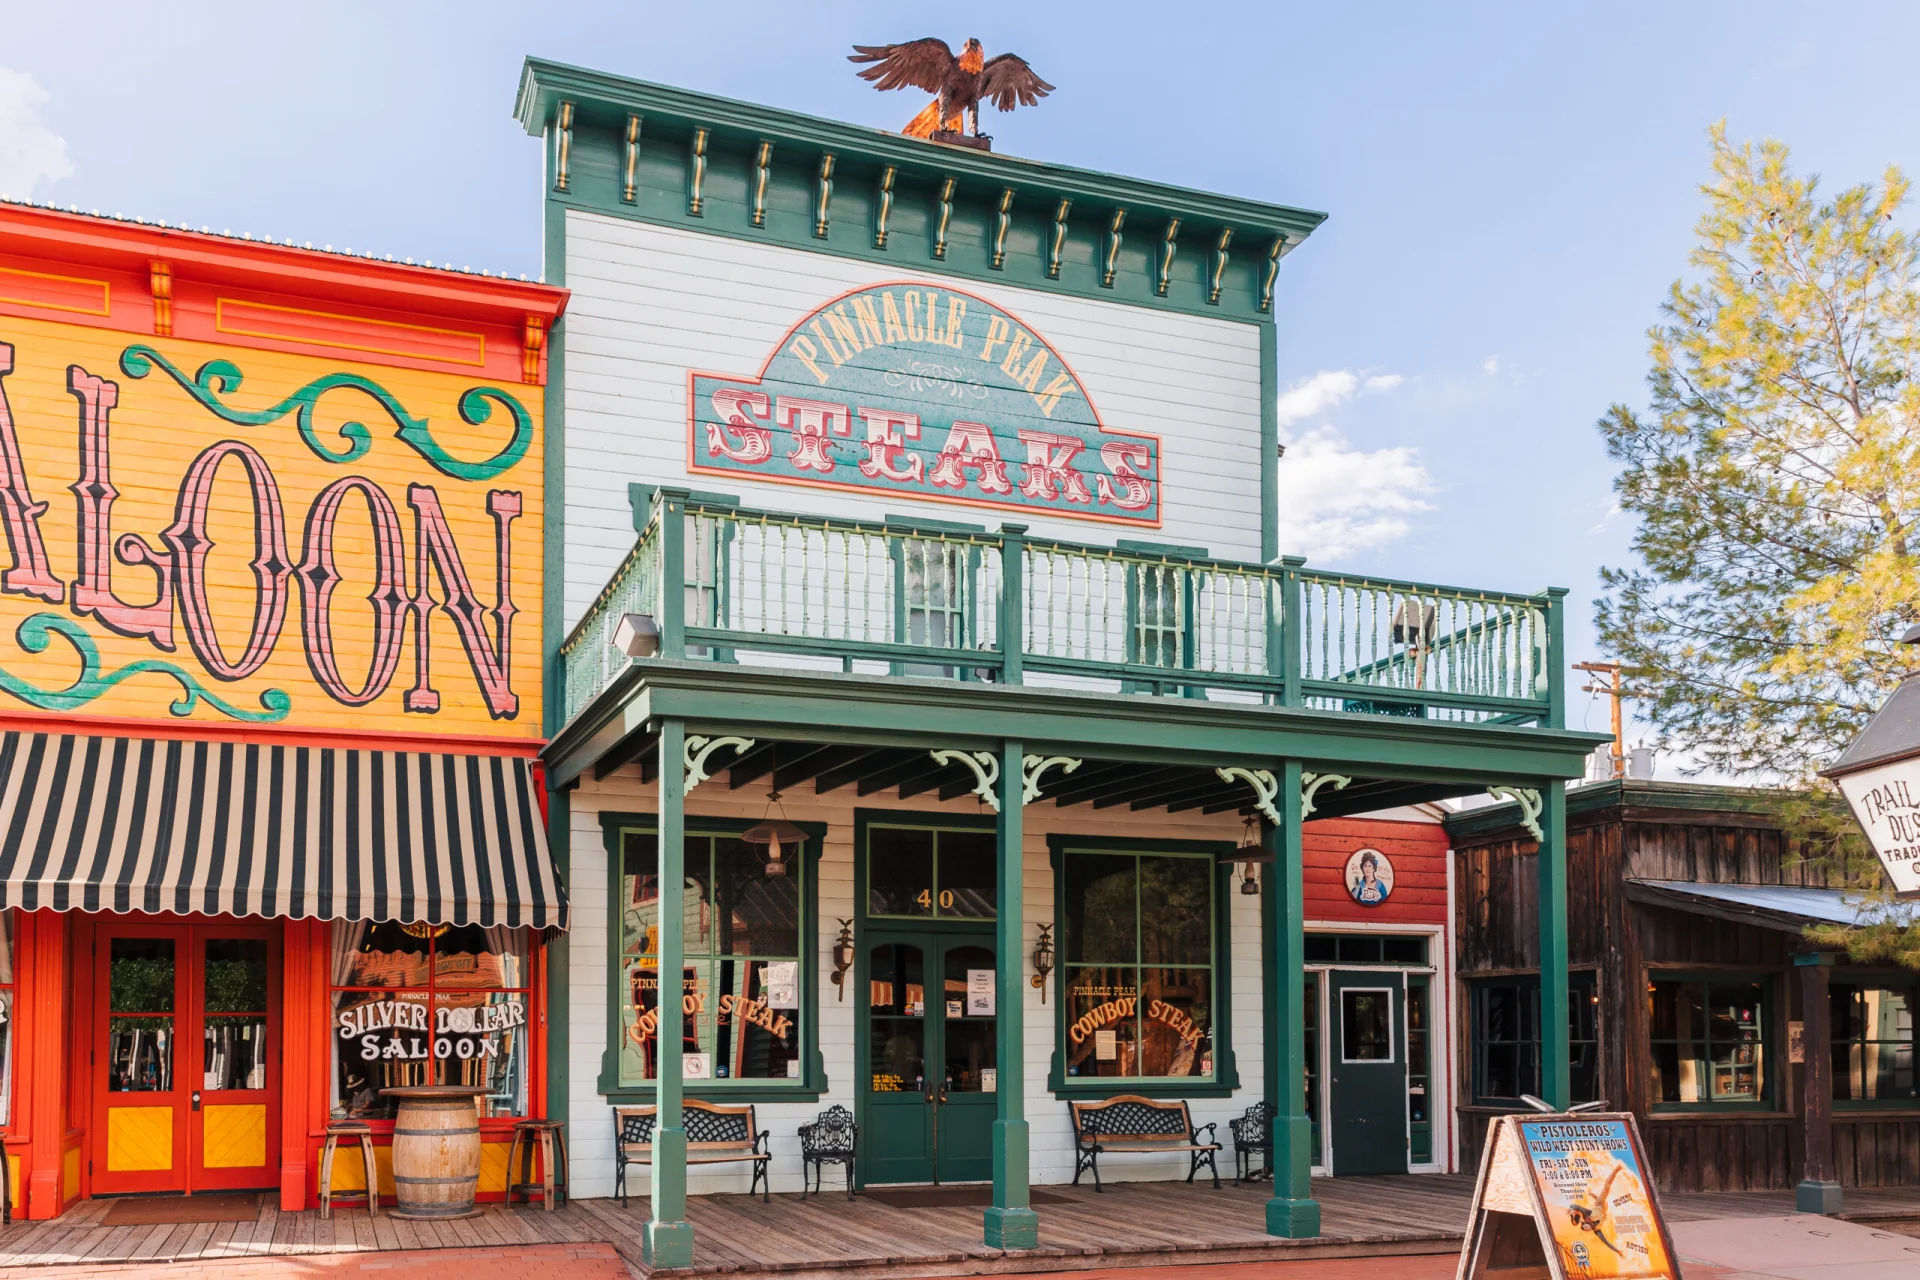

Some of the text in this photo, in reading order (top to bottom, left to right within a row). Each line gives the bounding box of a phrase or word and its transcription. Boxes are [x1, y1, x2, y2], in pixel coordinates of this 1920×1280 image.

[788, 289, 1079, 417] PINNACLE PEAK
[705, 387, 1153, 512] STEAKS
[1861, 780, 1920, 825] TRAIL
[1073, 986, 1136, 996] PINNACLE PEAK
[339, 1000, 526, 1040] SILVER DOLLAR
[718, 994, 793, 1039] STEAK
[1070, 998, 1137, 1044] COWBOY
[1147, 999, 1205, 1051] STEAK
[360, 1034, 500, 1060] SALOON
[1530, 1138, 1628, 1152] WILD WEST STUNT SHOWS
[1540, 1124, 1611, 1138] PISTOLEROS
[1539, 1159, 1553, 1168] FRI
[1557, 1159, 1570, 1168] SAT
[1575, 1158, 1589, 1168] SUN
[1580, 1169, 1593, 1178] PM
